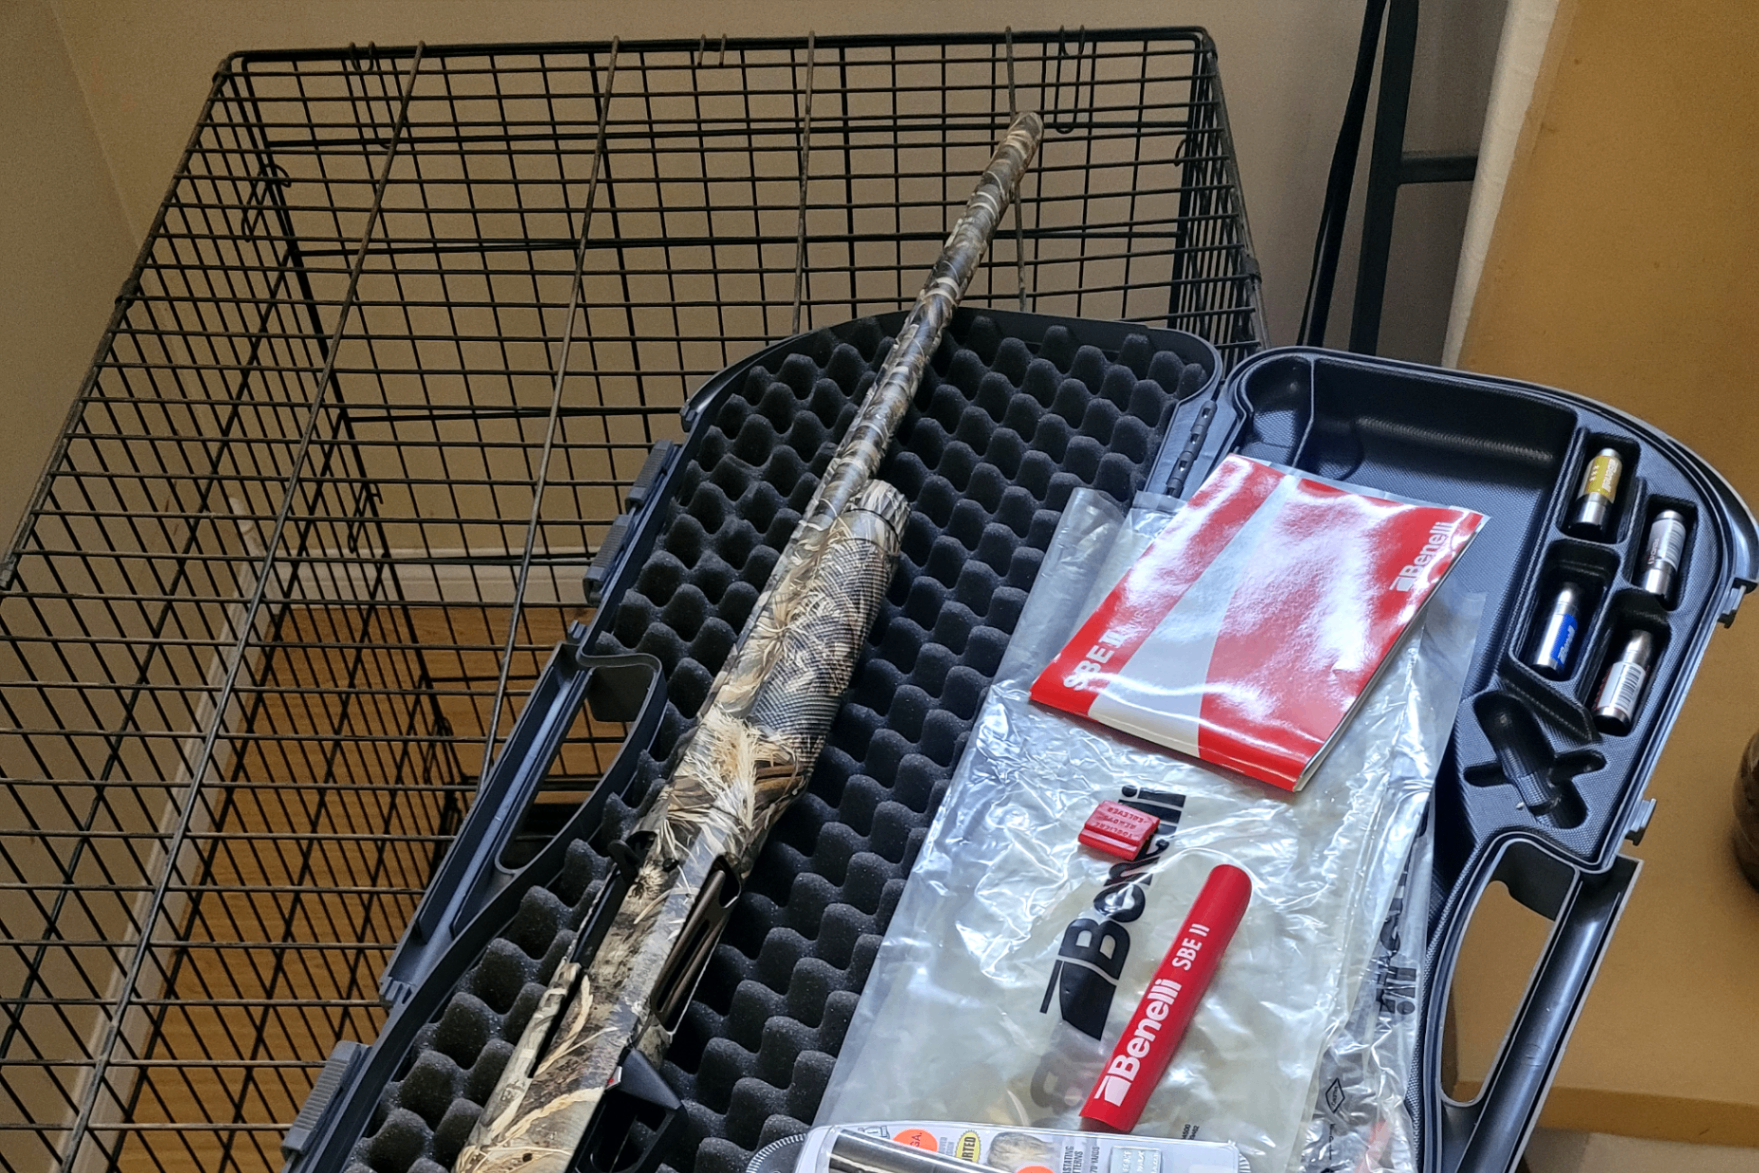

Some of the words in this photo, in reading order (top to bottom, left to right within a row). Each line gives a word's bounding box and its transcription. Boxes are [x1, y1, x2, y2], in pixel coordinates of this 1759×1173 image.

[1398, 521, 1454, 578] Benelli
[1063, 645, 1115, 691] SBE
[1108, 978, 1182, 1082] Benelli
[1172, 935, 1203, 971] SBE
